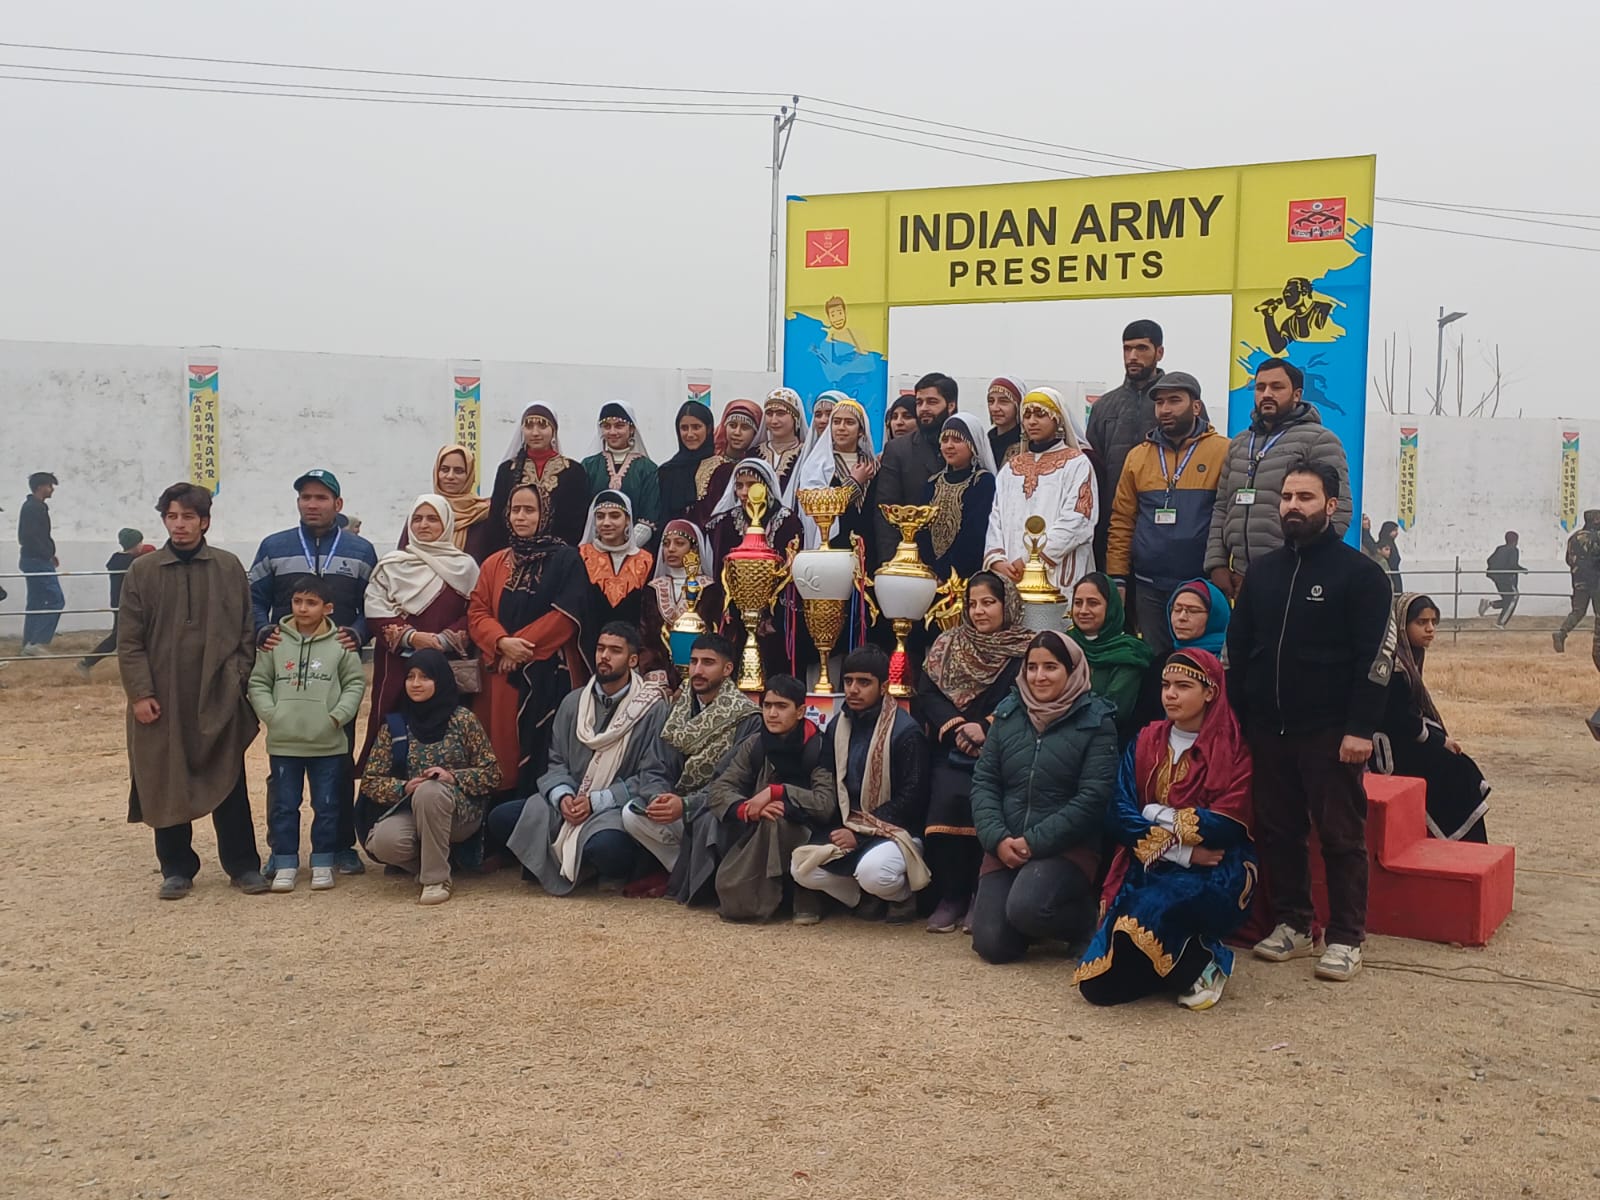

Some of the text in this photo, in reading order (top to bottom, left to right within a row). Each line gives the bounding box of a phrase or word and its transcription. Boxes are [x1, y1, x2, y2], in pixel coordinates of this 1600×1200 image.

[899, 195, 1225, 253] INDIAN ARMY
[949, 250, 1164, 288] PRESENTS
[205, 400, 215, 479] FANKAAR
